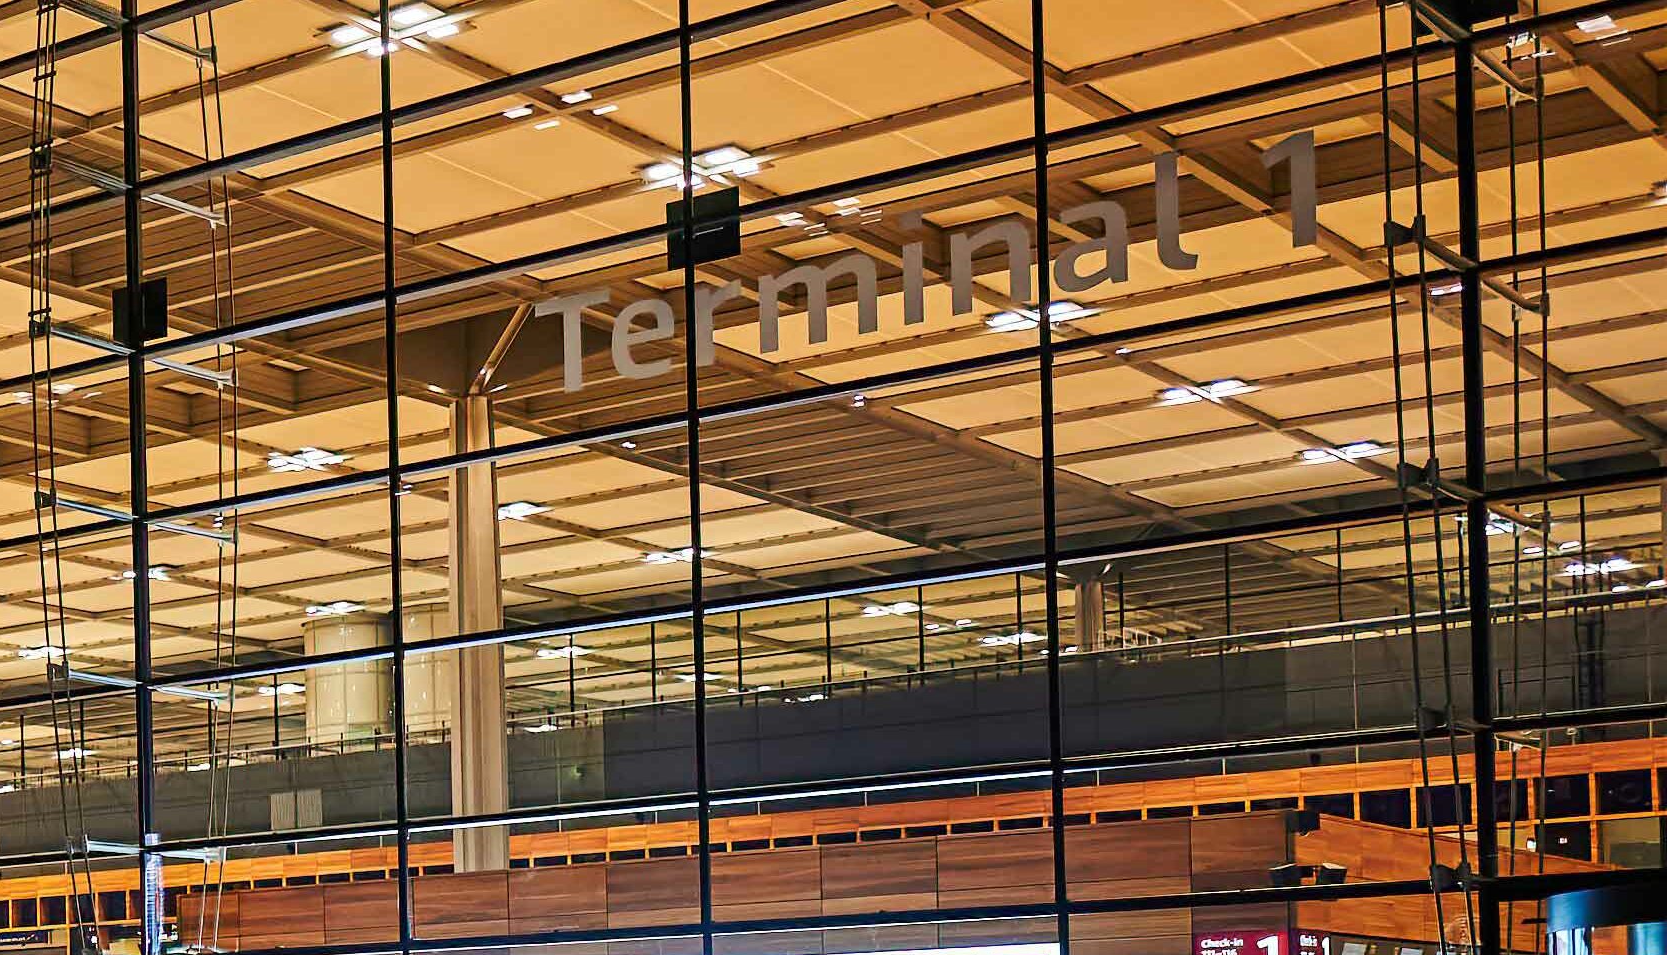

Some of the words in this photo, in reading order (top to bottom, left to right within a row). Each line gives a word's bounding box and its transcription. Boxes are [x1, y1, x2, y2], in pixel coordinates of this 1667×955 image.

[535, 151, 1200, 393] Terminal
[1257, 130, 1318, 249] 1
[1200, 937, 1244, 949] Check-in
